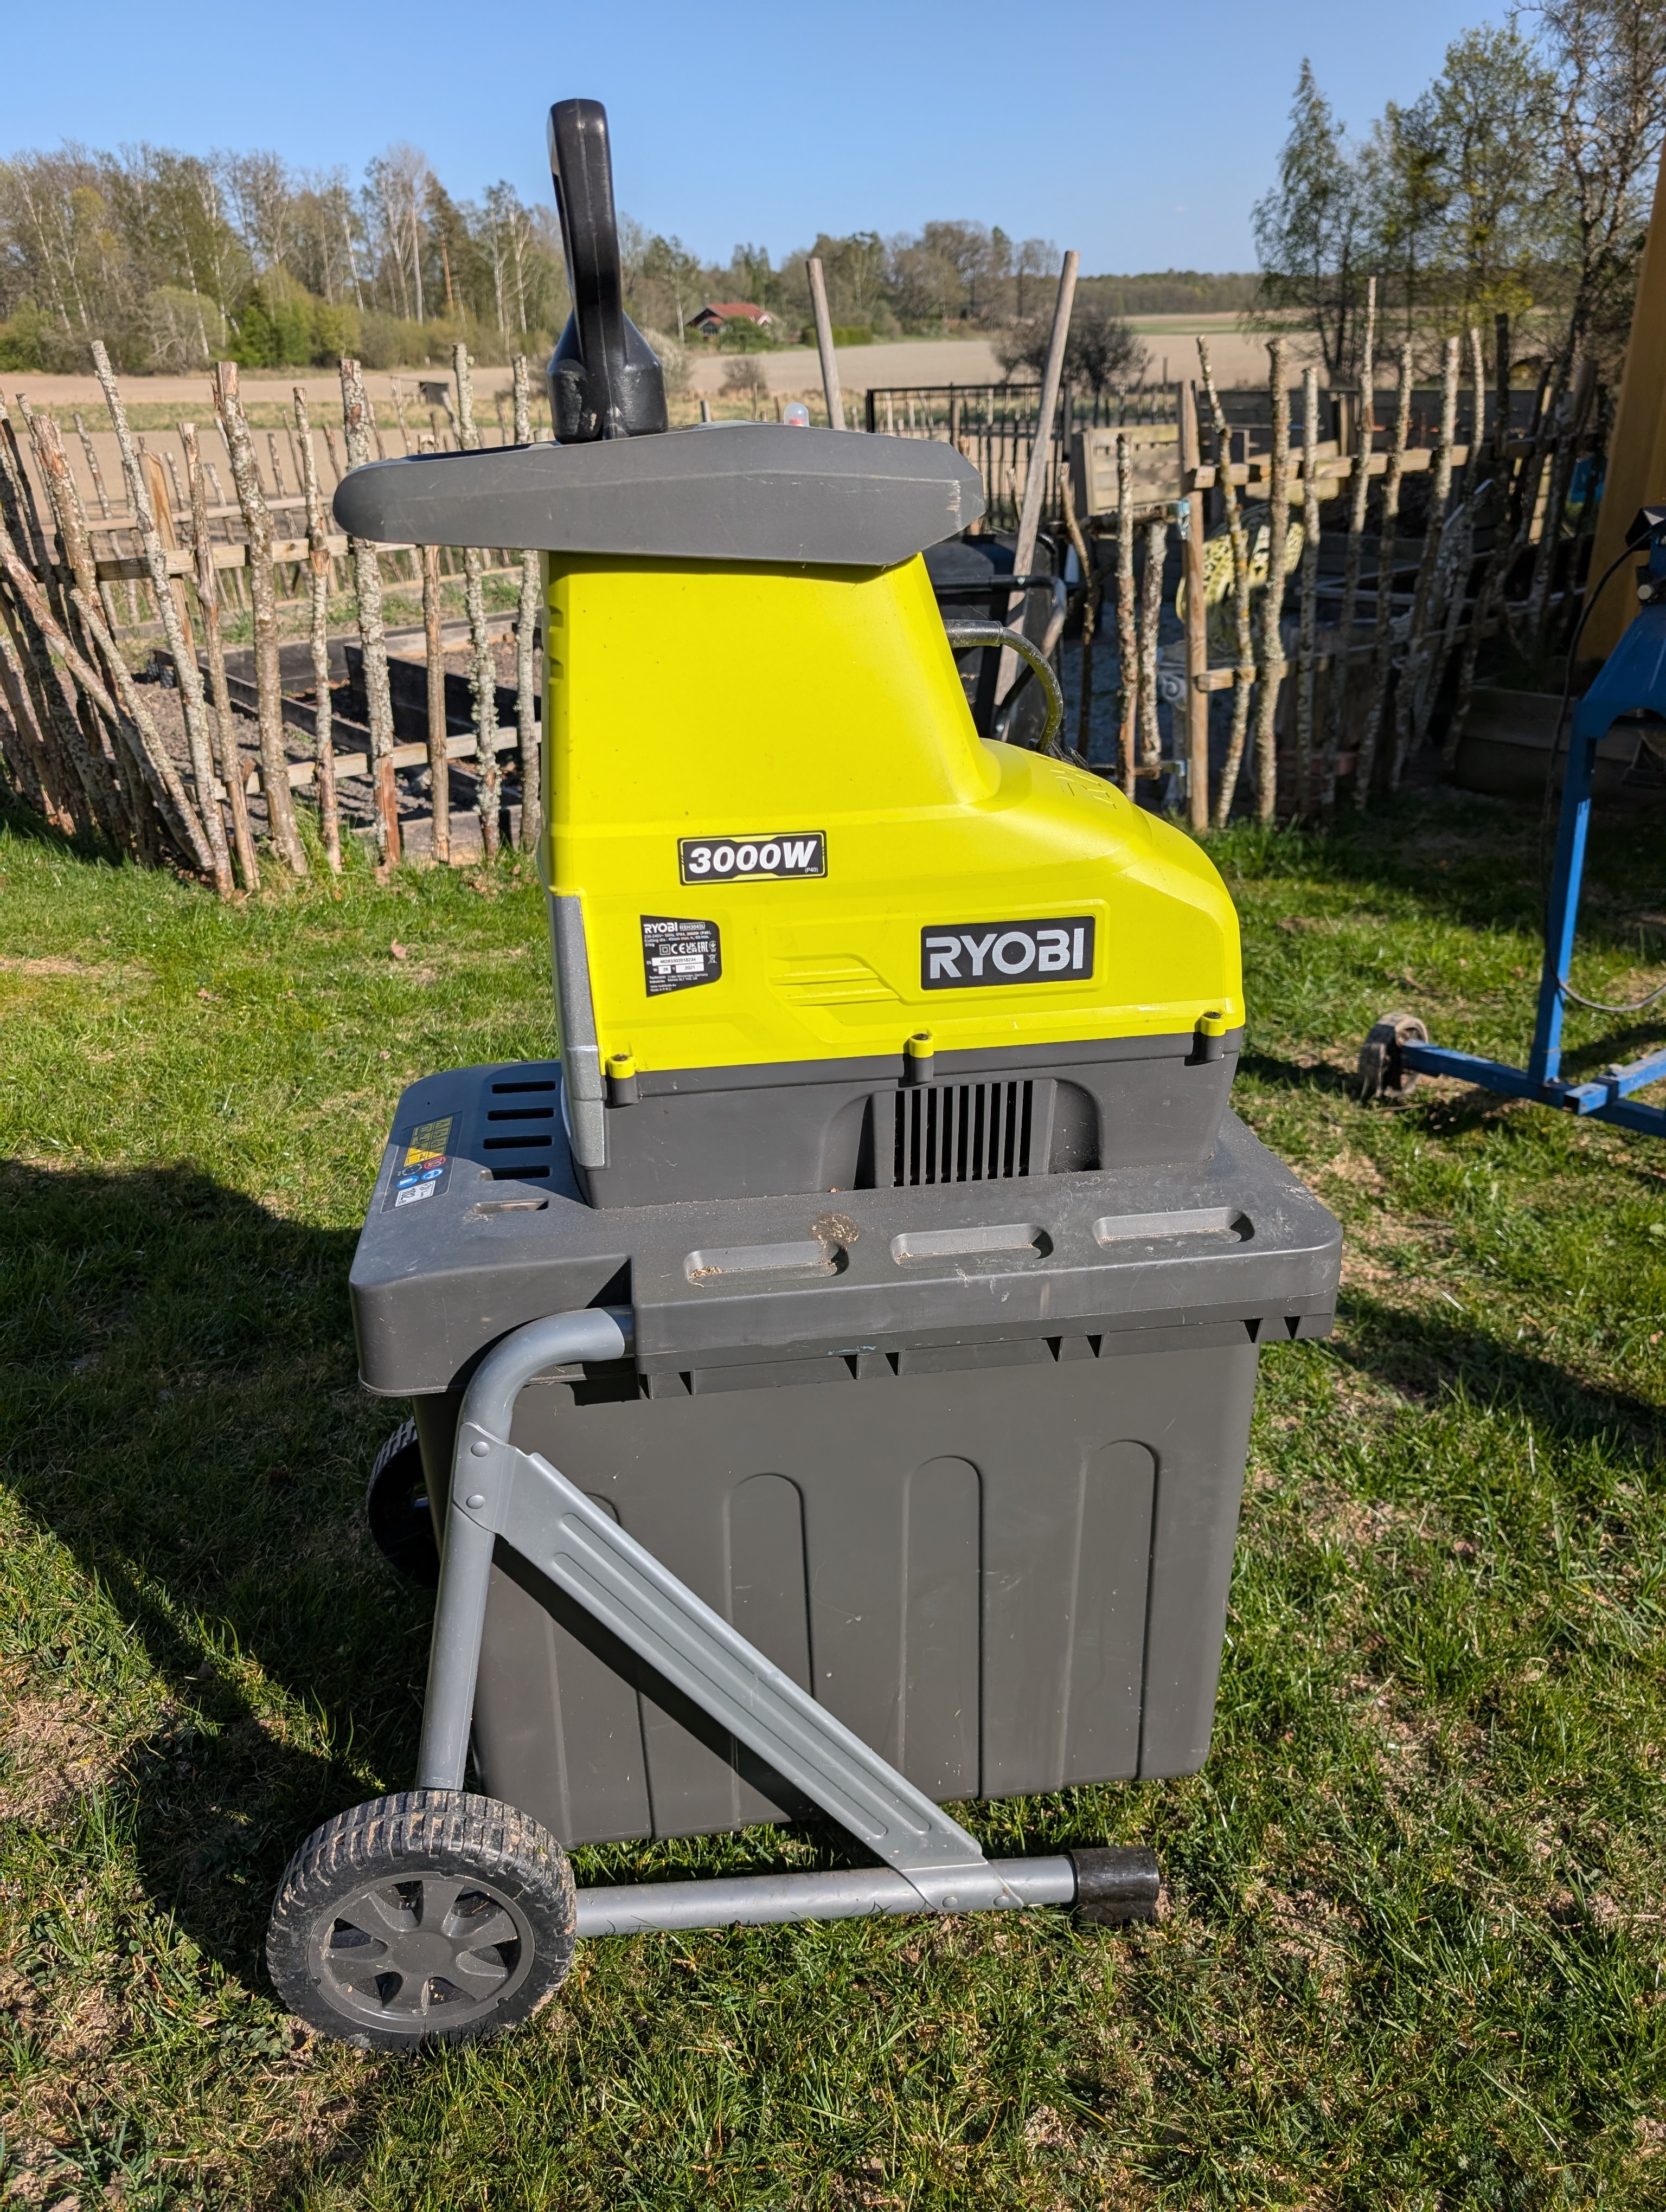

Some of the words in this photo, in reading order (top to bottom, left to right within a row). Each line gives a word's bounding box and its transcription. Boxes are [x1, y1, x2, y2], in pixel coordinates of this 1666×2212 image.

[688, 841, 817, 874] 3000W
[644, 922, 678, 934] RYOBI
[671, 943, 685, 954] CE
[926, 928, 1085, 979] RYOBI
